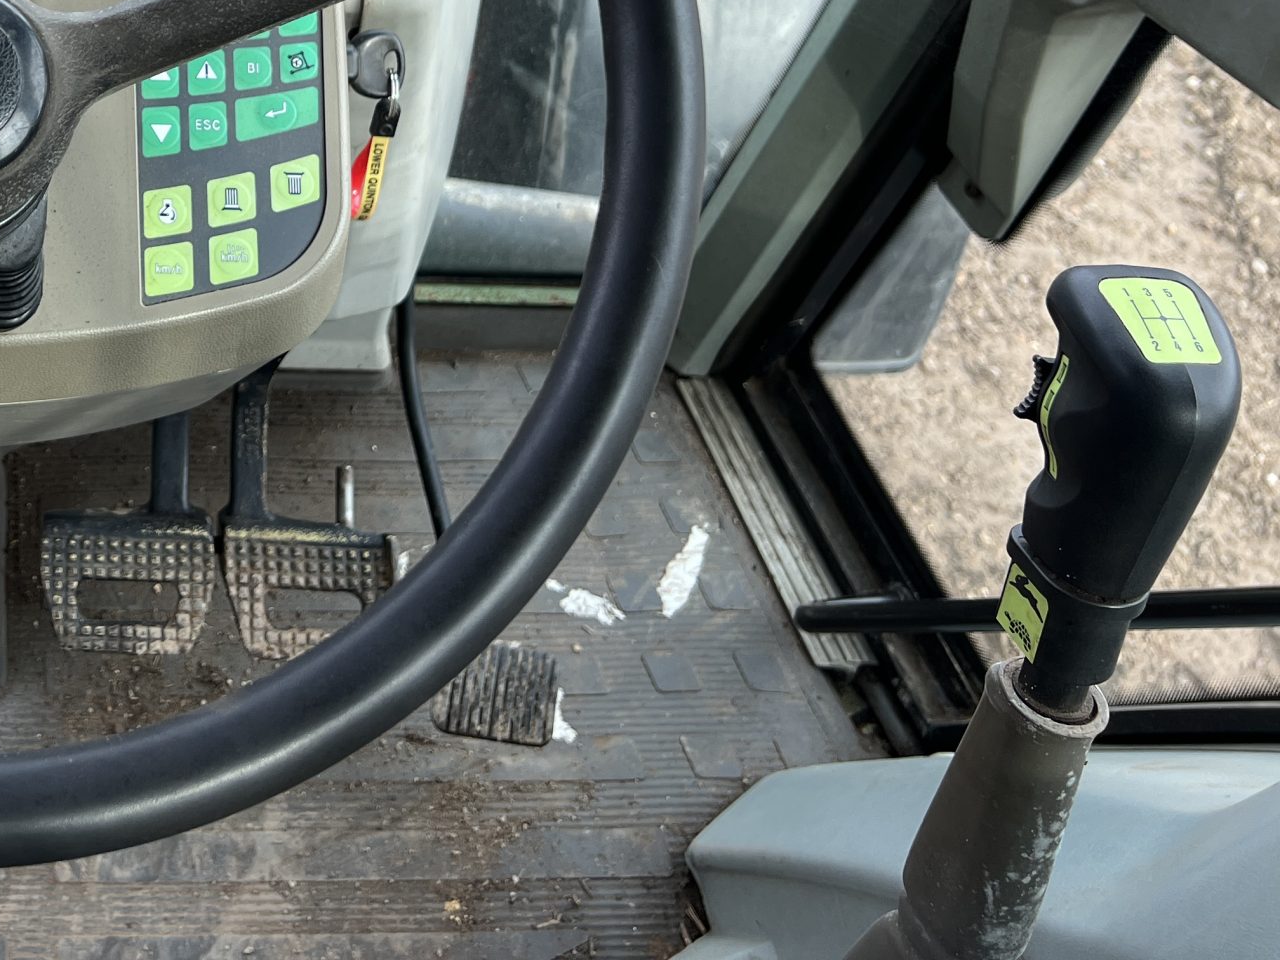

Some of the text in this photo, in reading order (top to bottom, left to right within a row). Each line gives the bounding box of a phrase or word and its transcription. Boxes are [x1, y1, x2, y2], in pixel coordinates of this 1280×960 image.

[195, 118, 221, 131] ESC
[370, 143, 385, 175] LOWER
[1142, 287, 1153, 297] 3
[1162, 288, 1173, 298] 5
[1151, 340, 1204, 353] 2 4 6
